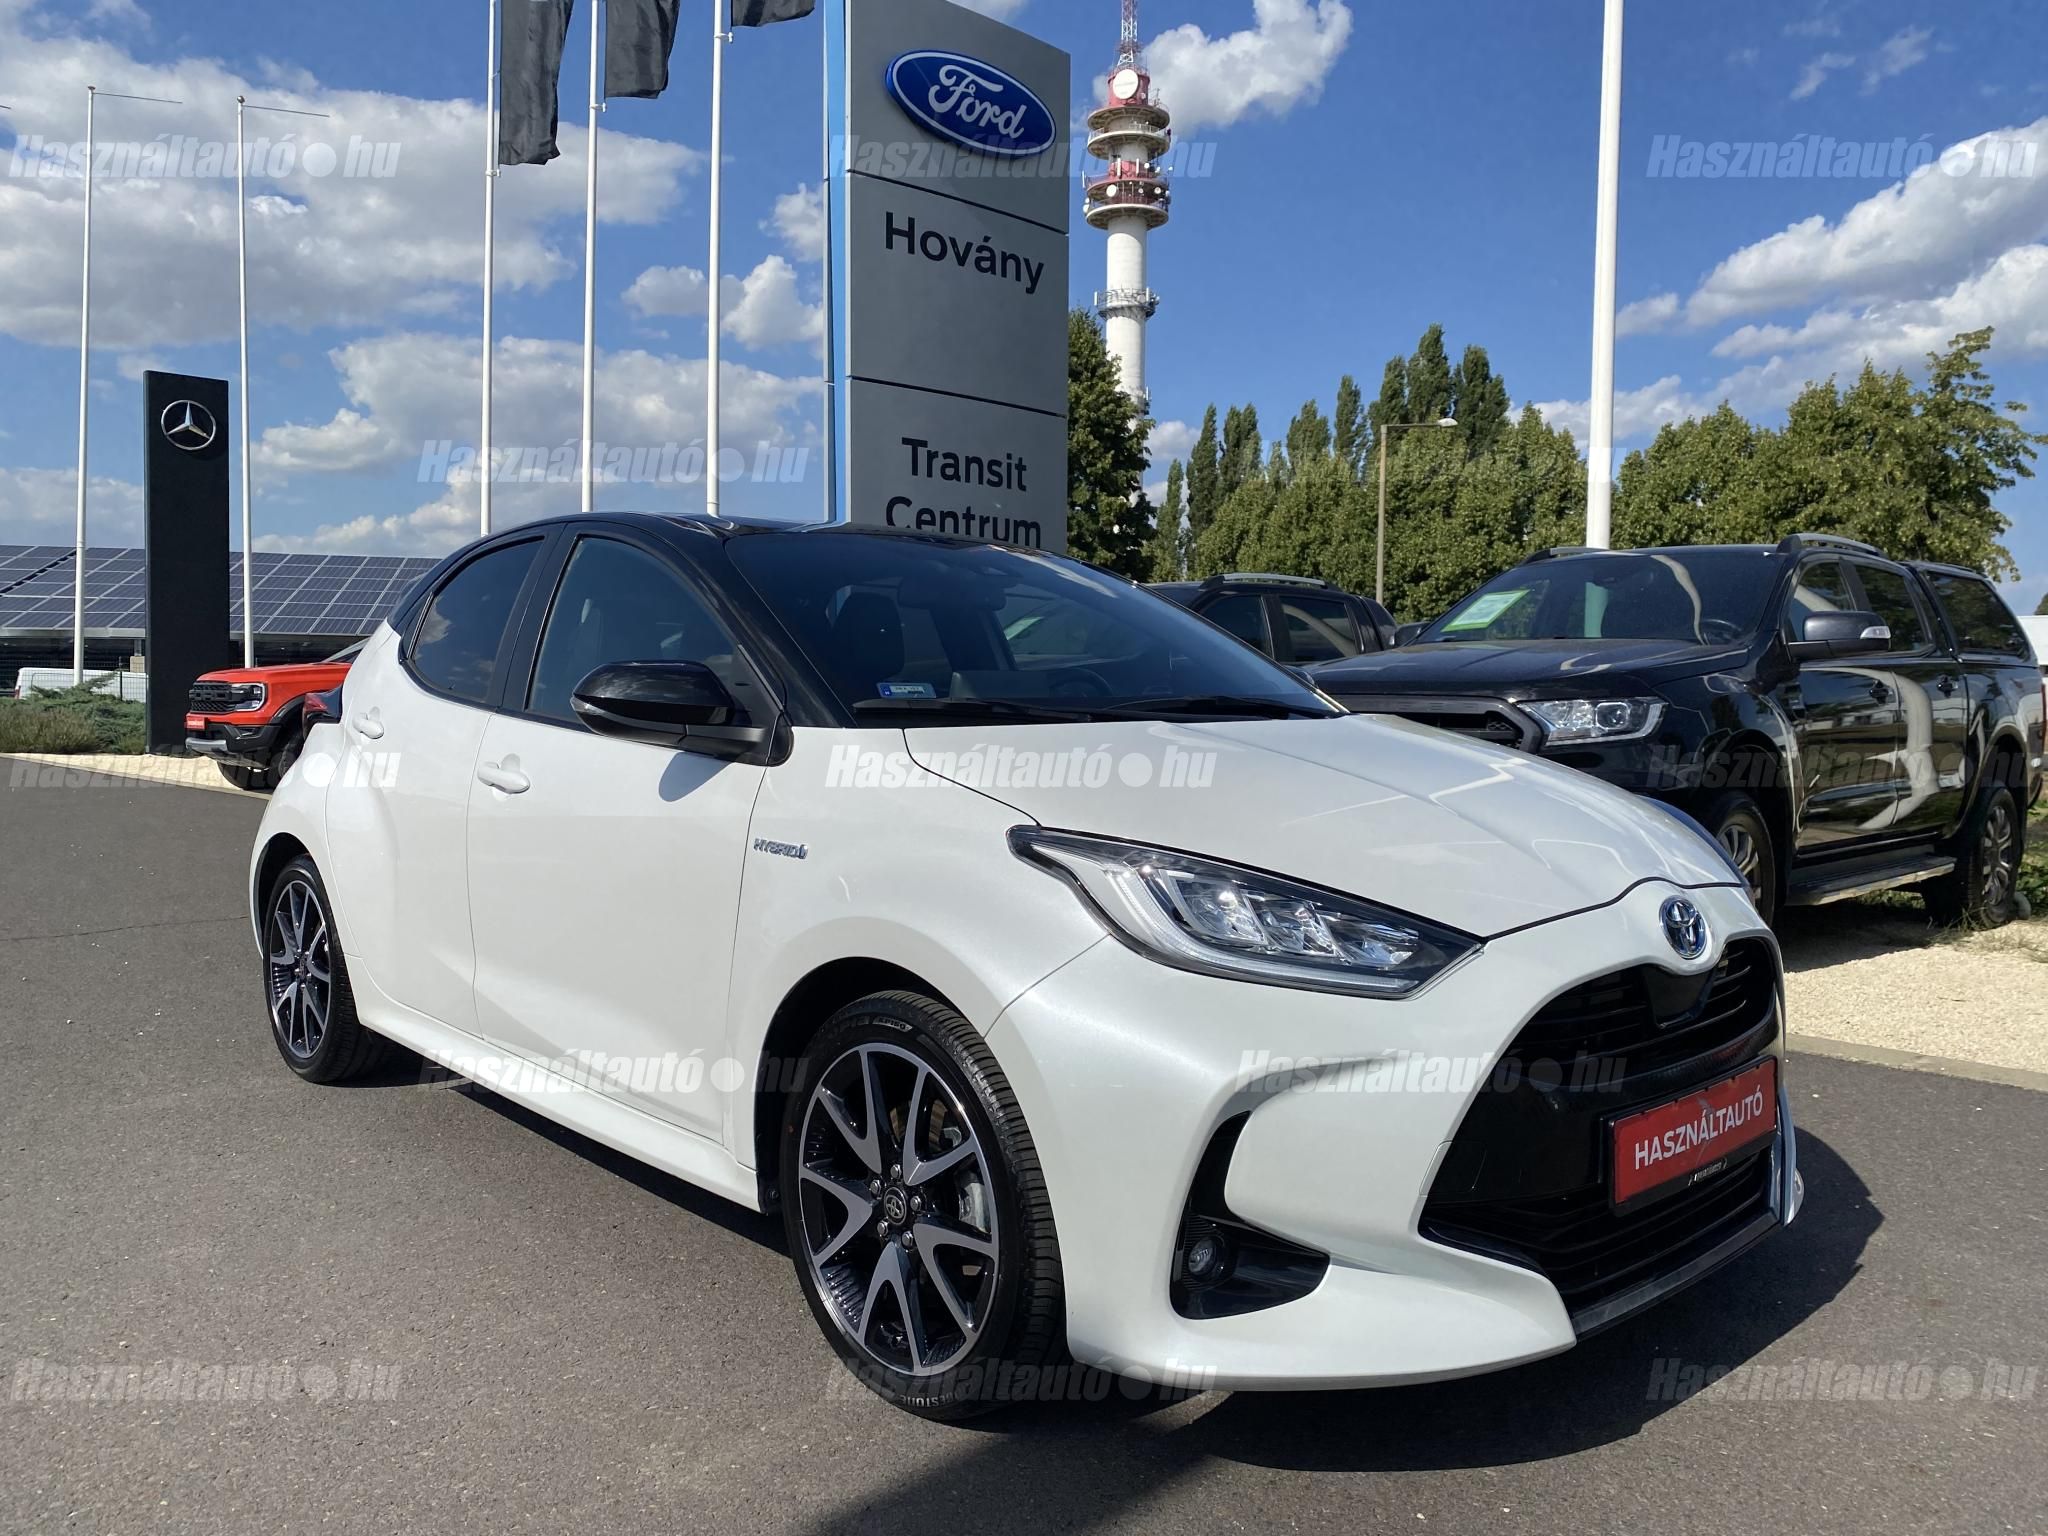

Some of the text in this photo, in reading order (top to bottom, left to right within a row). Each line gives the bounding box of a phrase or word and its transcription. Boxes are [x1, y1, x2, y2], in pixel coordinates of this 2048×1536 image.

[928, 65, 1027, 139] Ford
[886, 211, 1044, 294] Hovány
[902, 437, 1027, 491] Transit
[886, 496, 1041, 548] Centrum
[1635, 1085, 1763, 1170] HASZNÁLTAUTÓ
